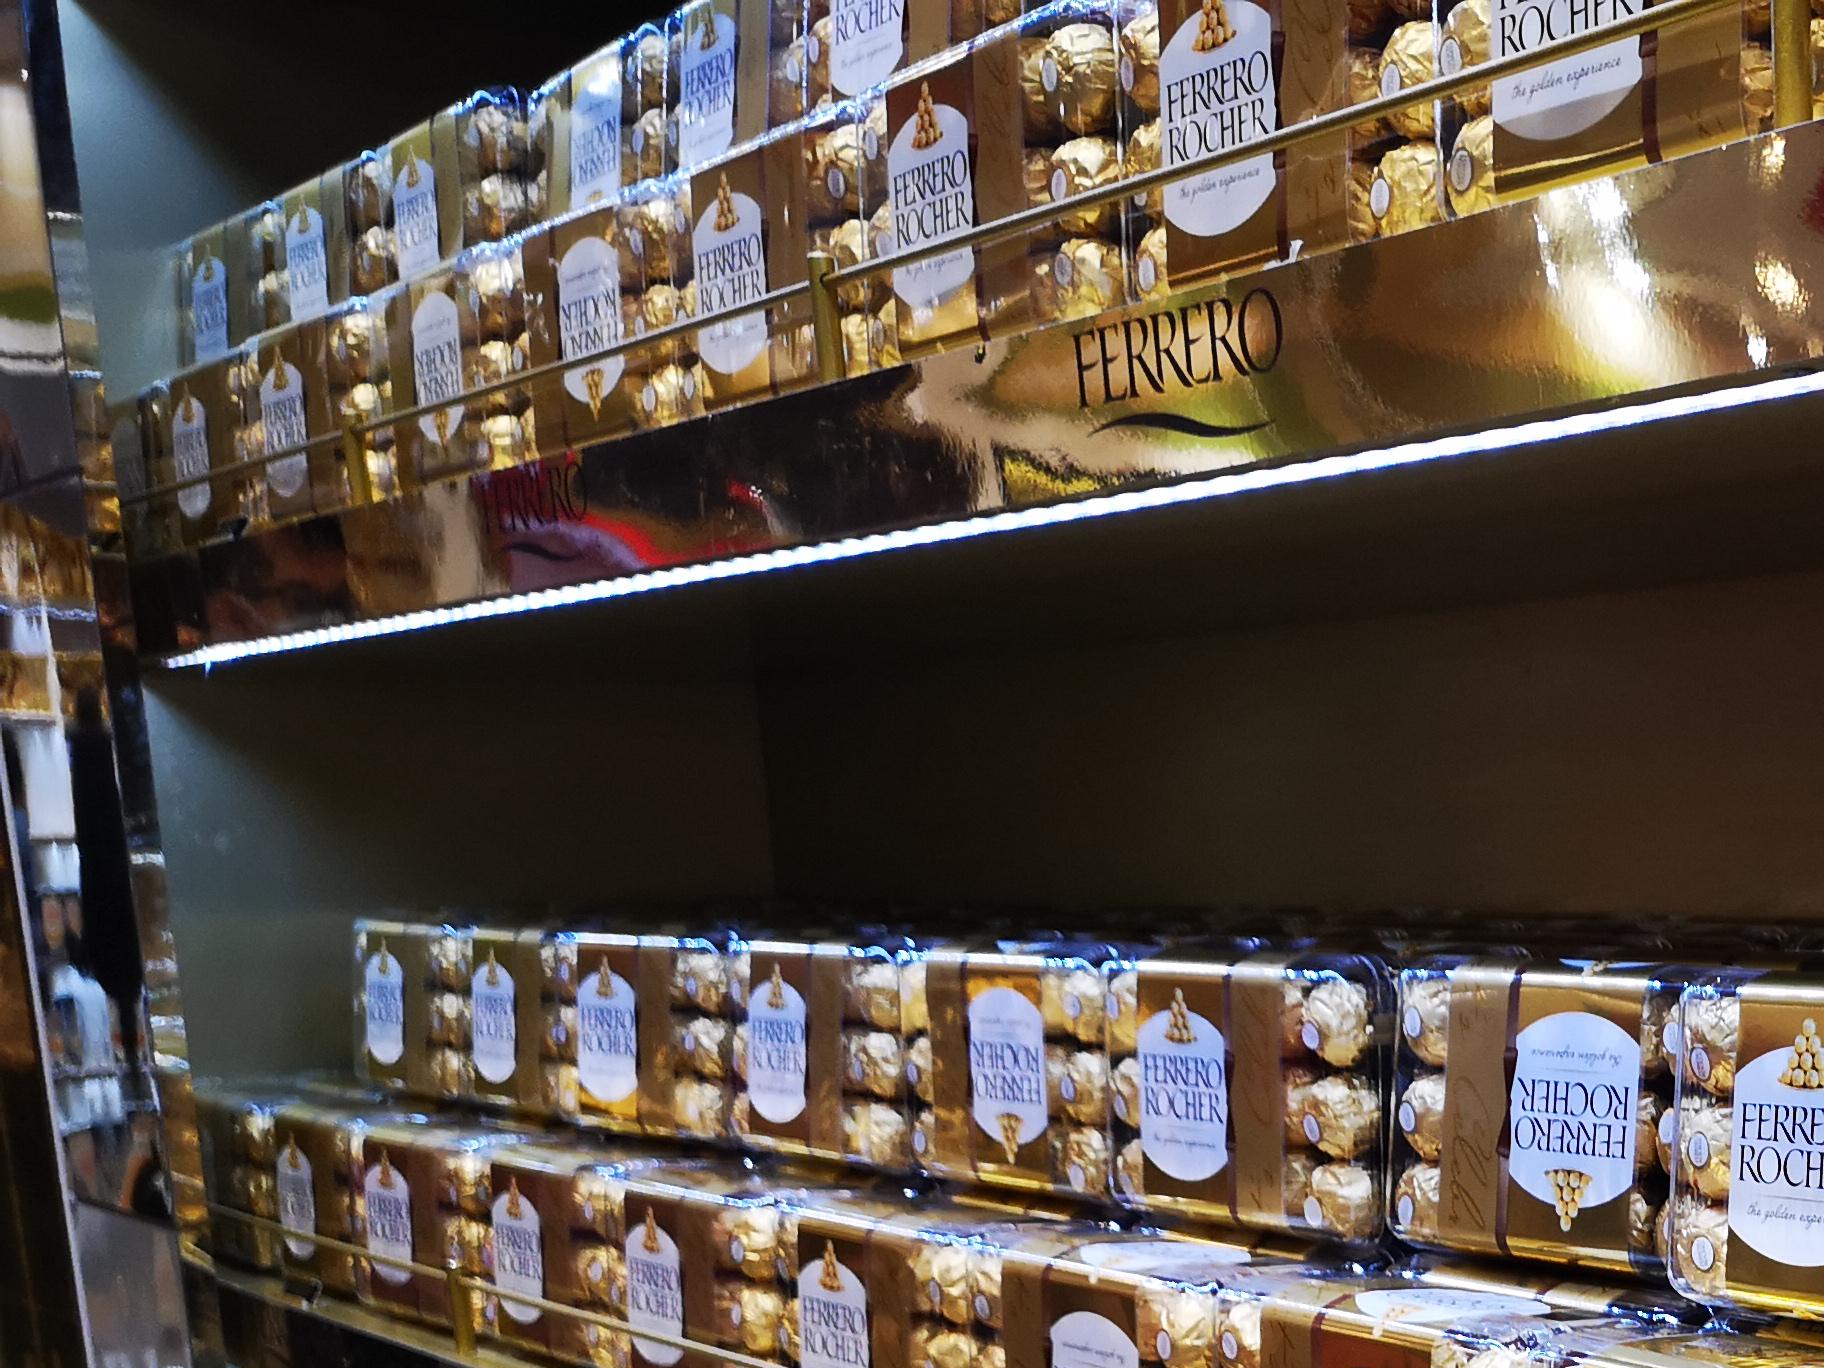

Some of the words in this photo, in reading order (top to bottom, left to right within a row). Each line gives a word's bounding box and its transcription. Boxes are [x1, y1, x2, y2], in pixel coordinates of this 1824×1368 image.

[1167, 50, 1268, 122] FERRERO
[1168, 98, 1269, 165] ROCHER
[893, 150, 967, 210] FERRERO
[896, 192, 969, 248] ROCHER
[698, 233, 760, 284] FERRERO
[700, 270, 762, 315] ROCHER
[1074, 287, 1284, 406] FERRERO
[1143, 1053, 1223, 1088] FERRERO
[1145, 1087, 1224, 1124] ROCHER
[1517, 1076, 1630, 1121] ROCHER
[1515, 1116, 1627, 1160] FERRERO
[1747, 1204, 1761, 1217] the
[1764, 1208, 1797, 1223] golden
[802, 1295, 865, 1334] FERRERO
[804, 1327, 867, 1368] ROCHER
